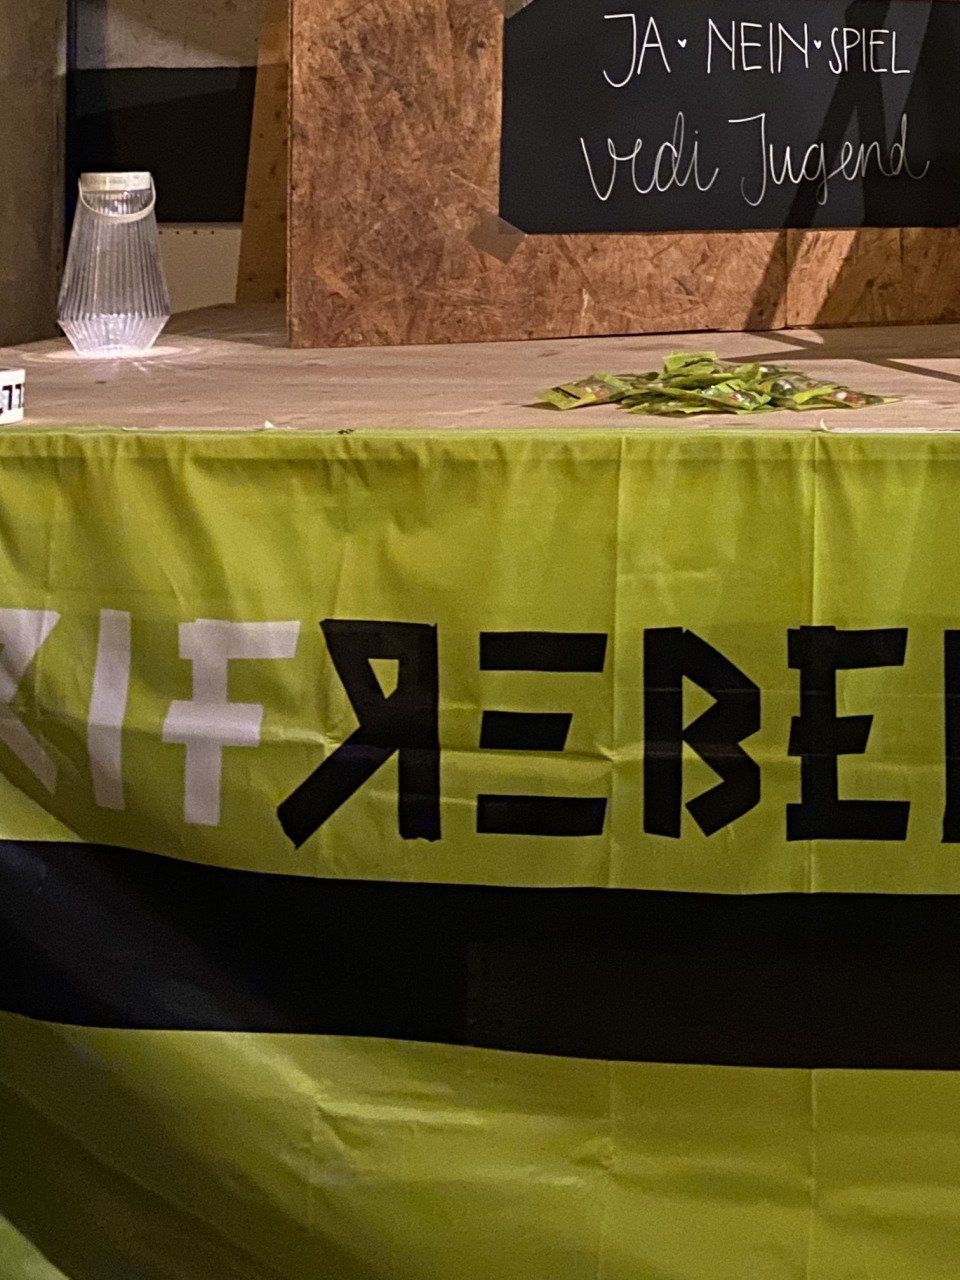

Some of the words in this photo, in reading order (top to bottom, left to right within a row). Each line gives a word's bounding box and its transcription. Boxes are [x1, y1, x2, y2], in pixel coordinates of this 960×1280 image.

[603, 13, 671, 87] JA
[707, 18, 809, 74] NEIN
[728, 112, 930, 206] Jugend
